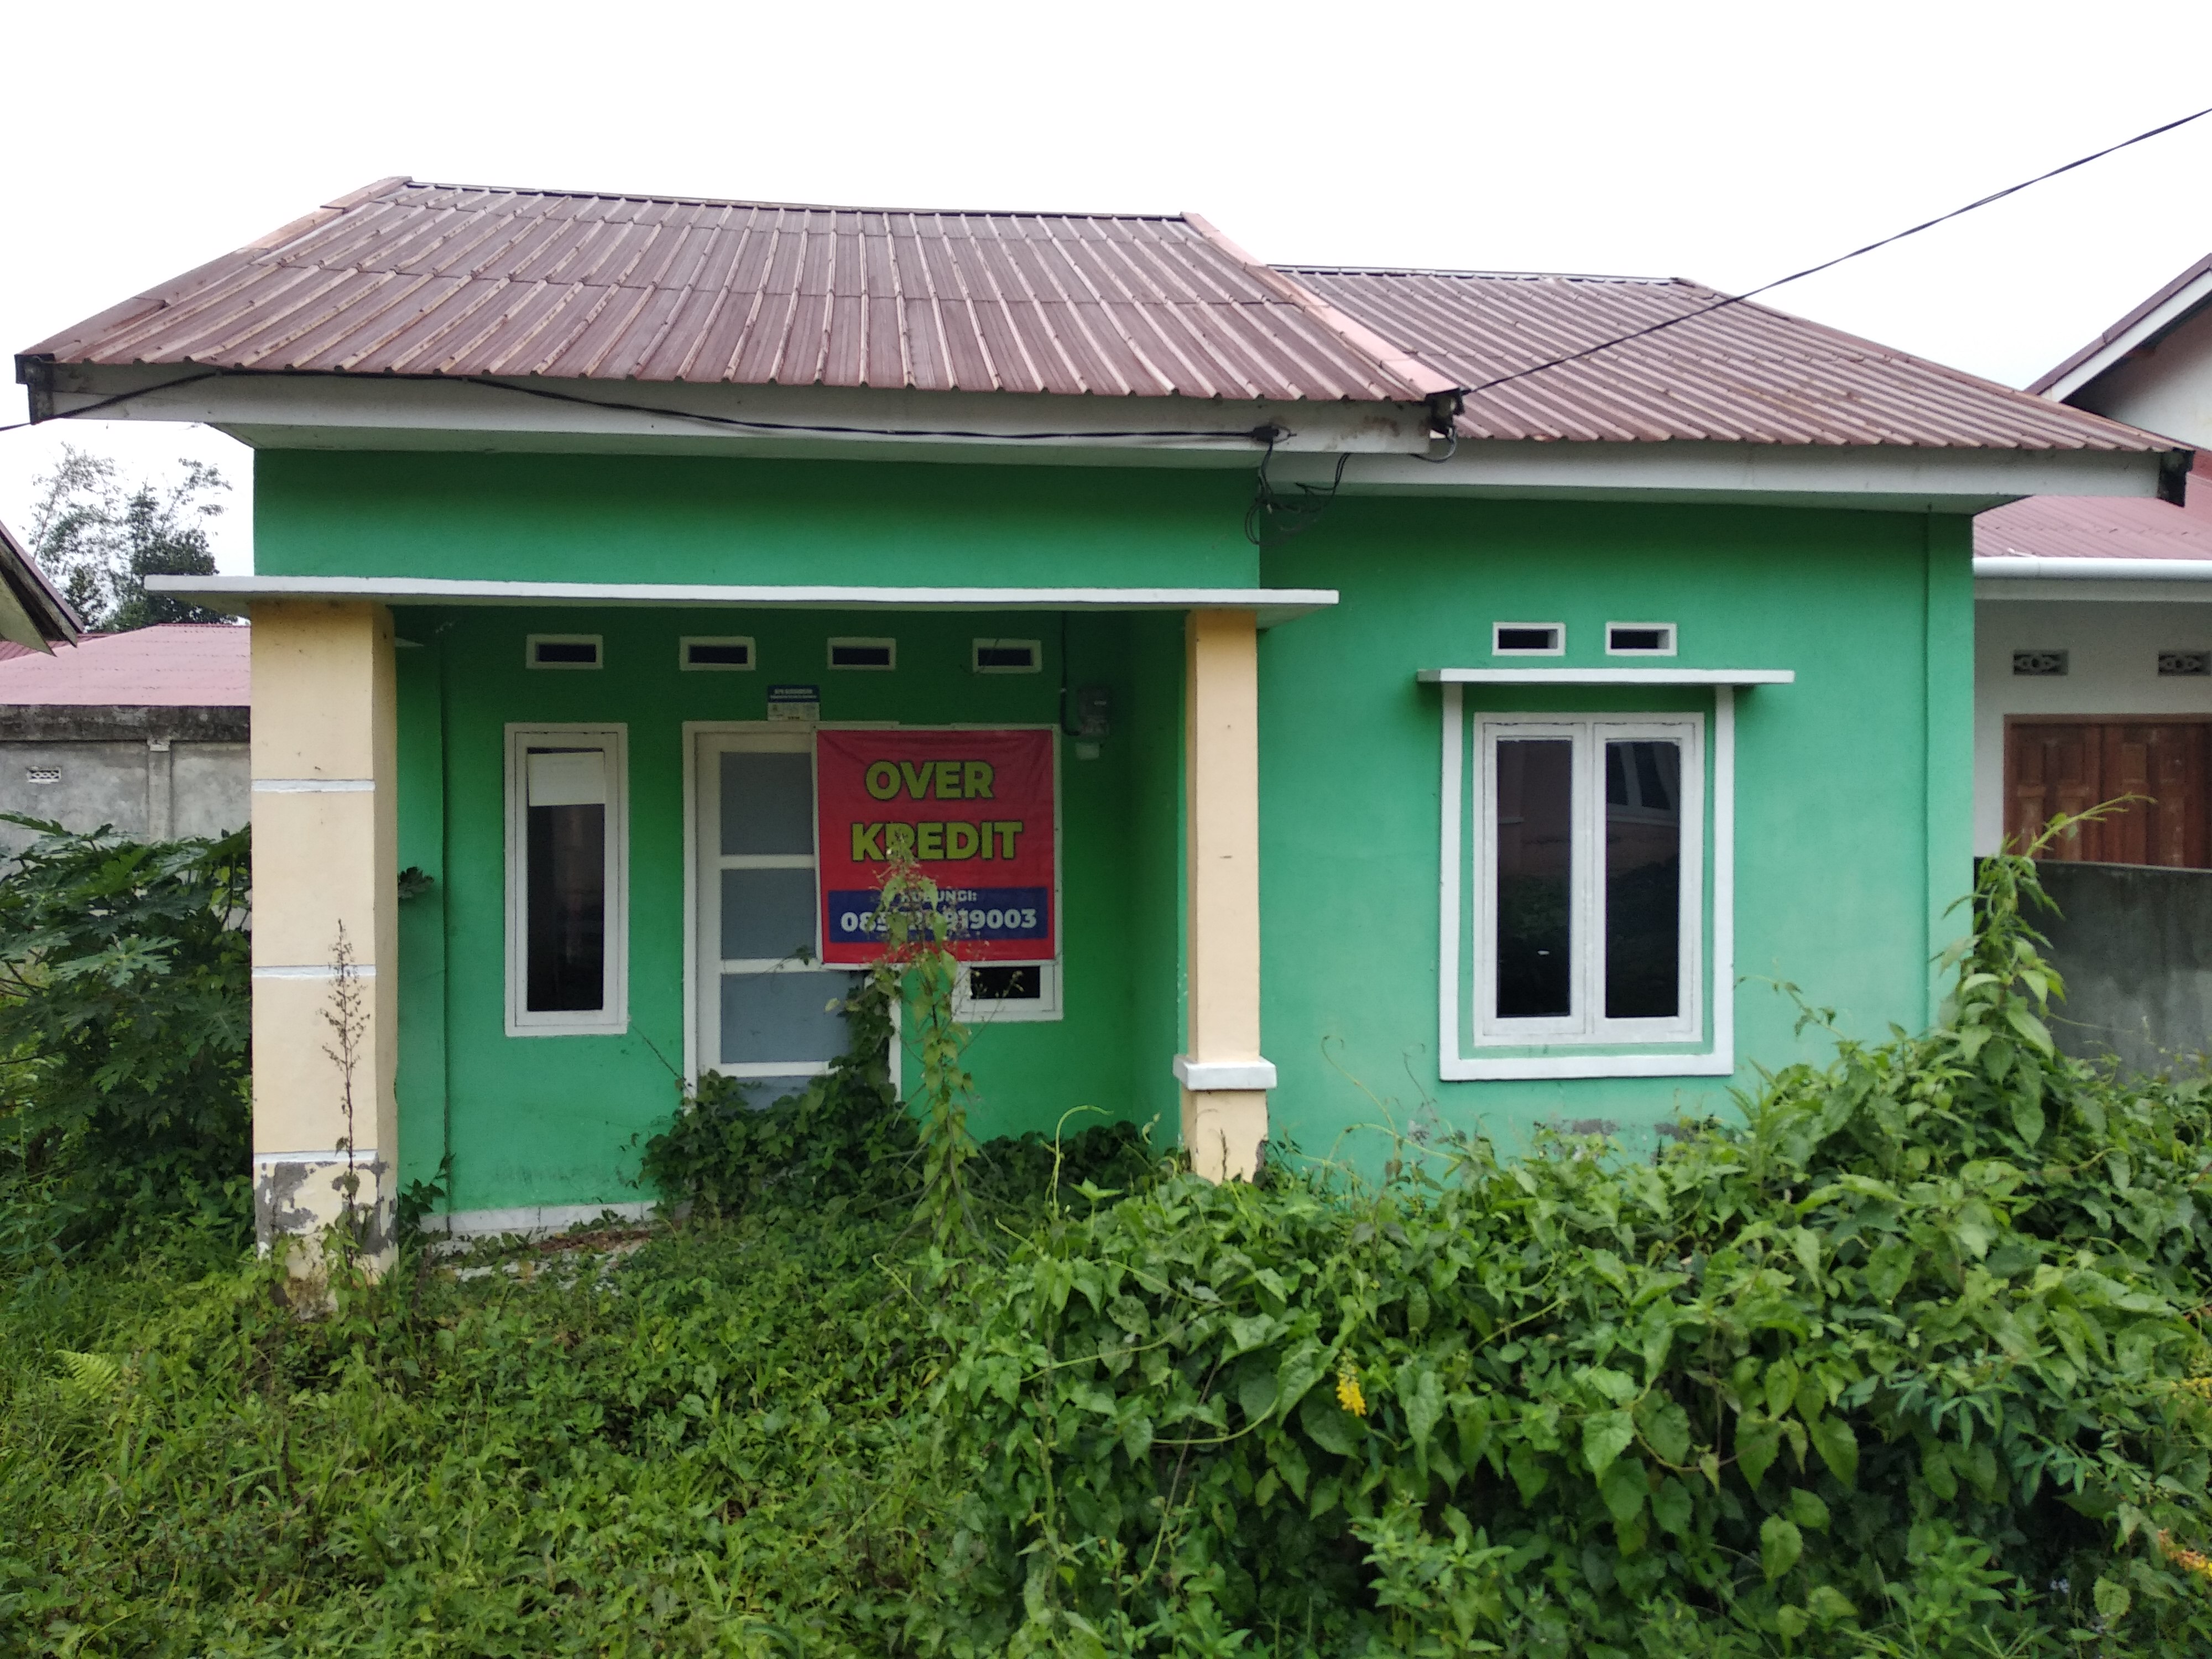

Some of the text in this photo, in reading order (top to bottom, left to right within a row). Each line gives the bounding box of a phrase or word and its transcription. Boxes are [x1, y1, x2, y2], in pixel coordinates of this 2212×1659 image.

[865, 760, 994, 800] OVER
[851, 821, 1023, 862] KREDIT
[841, 908, 1037, 932] 0852919003
